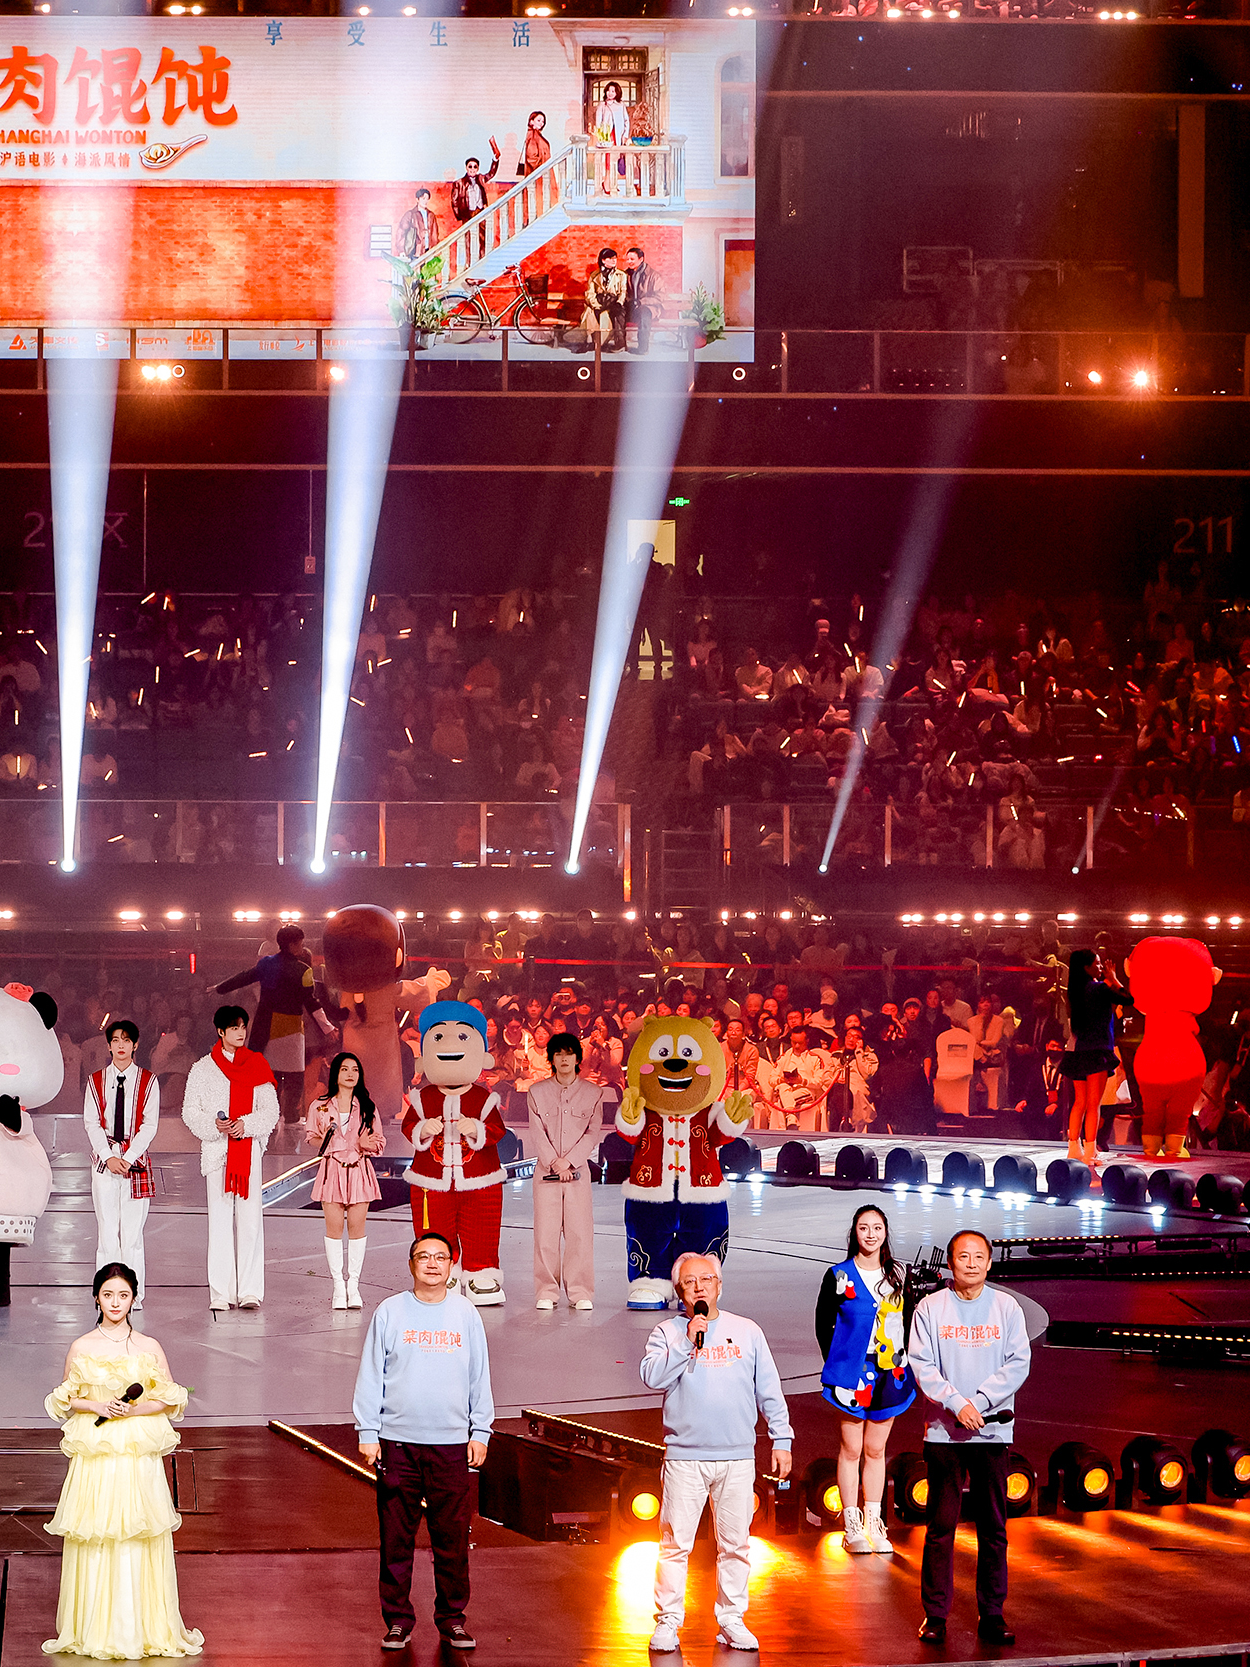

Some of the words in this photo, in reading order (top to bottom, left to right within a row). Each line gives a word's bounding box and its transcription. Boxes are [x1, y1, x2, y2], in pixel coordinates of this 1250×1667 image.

[75, 129, 147, 144] WONTON
[0, 151, 56, 168] 沪语电影
[74, 151, 132, 168] 海派风情
[1173, 516, 1233, 553] 211
[403, 1329, 462, 1348] 菜肉馄饨
[939, 1324, 1001, 1340] 菜肉馄饨
[691, 1345, 742, 1360] 肉馄饨
